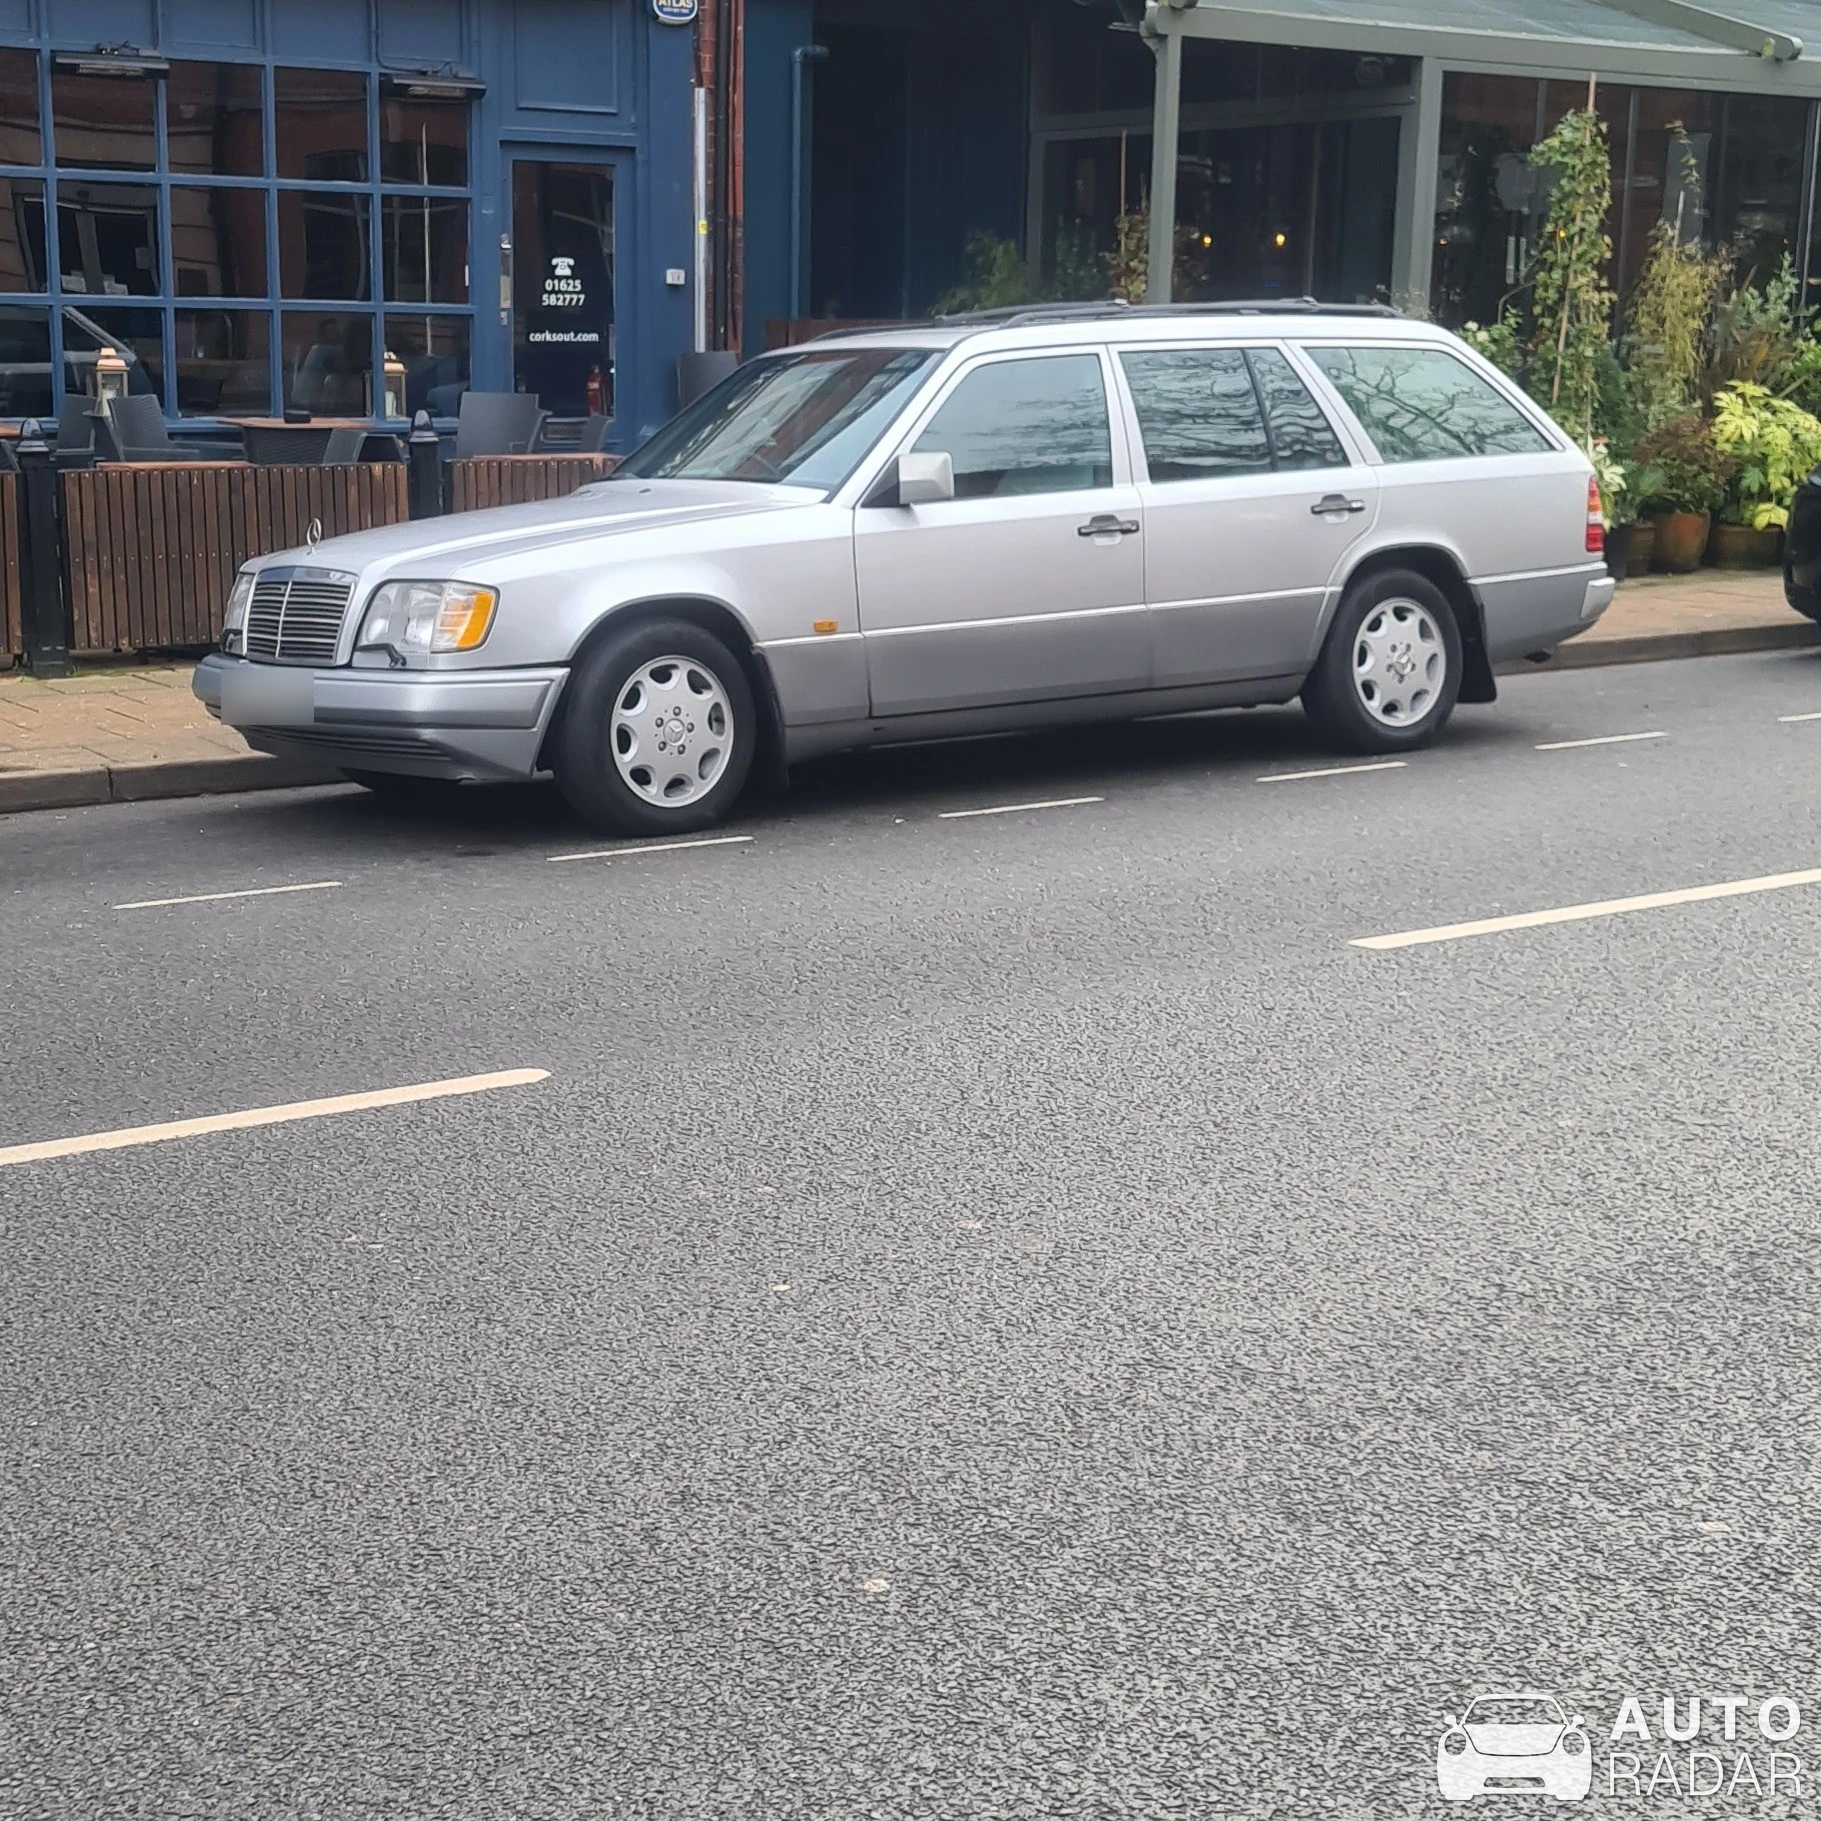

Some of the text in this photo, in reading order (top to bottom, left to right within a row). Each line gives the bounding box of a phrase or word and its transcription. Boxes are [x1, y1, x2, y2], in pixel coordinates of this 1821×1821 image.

[545, 279, 582, 291] 01625
[542, 293, 585, 306] 582777
[529, 330, 599, 342] corksout.com
